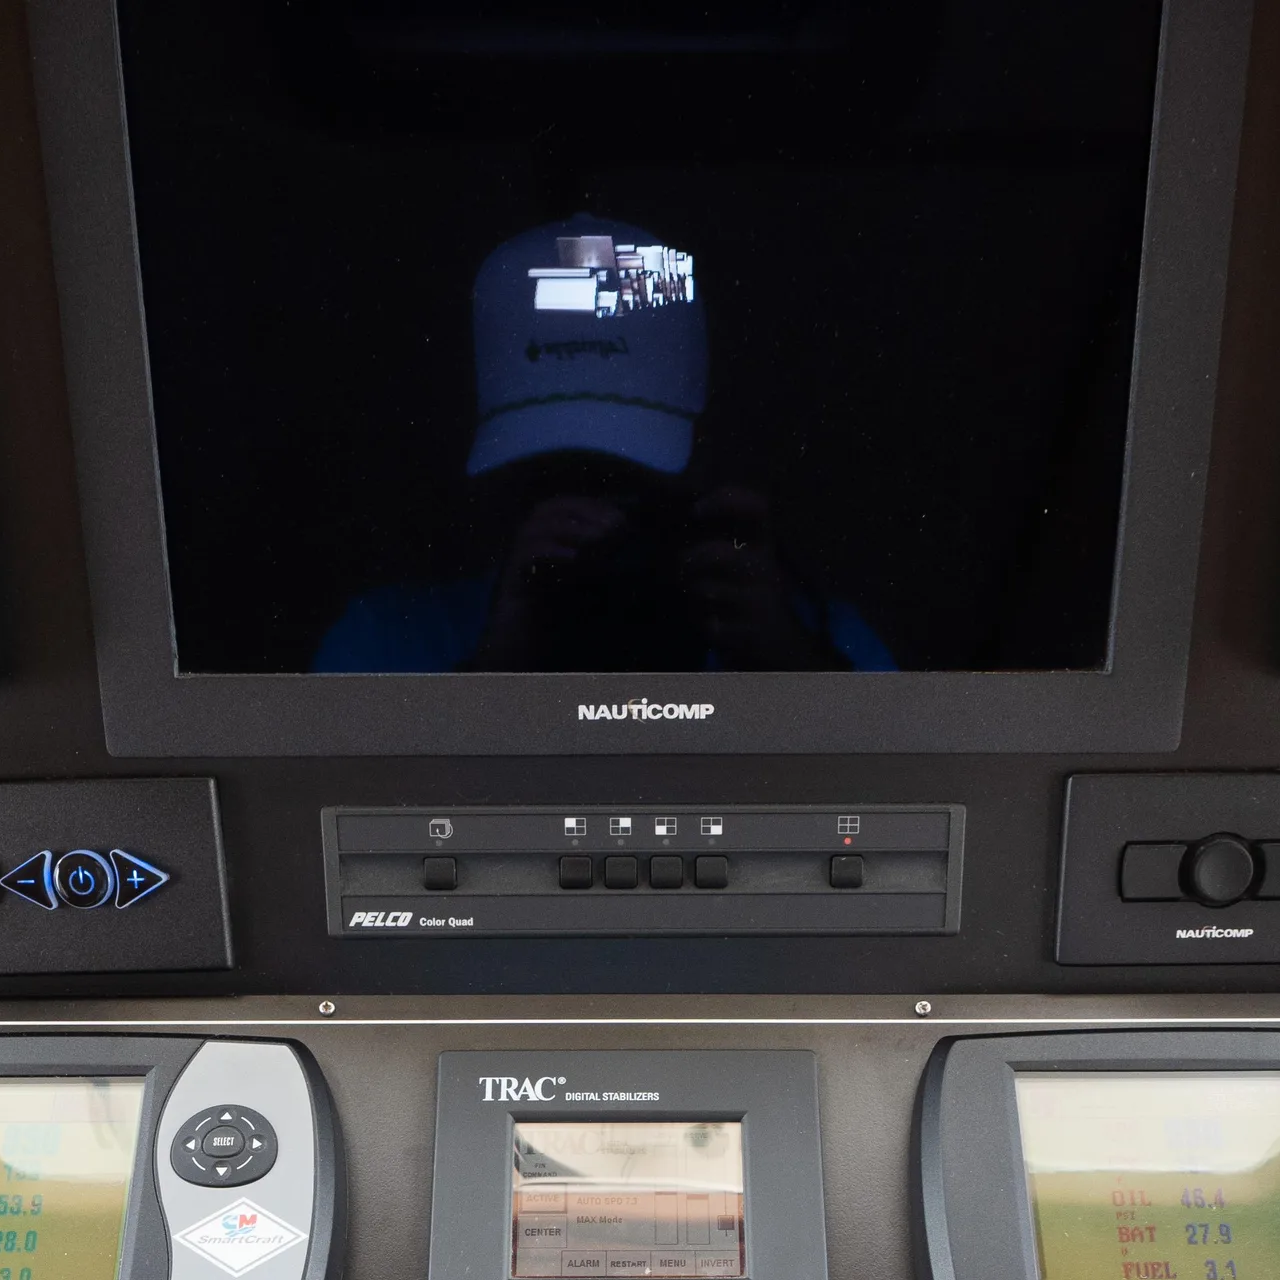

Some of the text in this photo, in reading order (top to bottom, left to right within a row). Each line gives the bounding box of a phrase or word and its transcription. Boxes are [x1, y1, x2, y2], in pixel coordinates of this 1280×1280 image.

[349, 912, 473, 927] PELCO Color Quad
[565, 1092, 601, 1101] DIGITAL
[602, 1092, 660, 1101] STABILIZERS
[213, 1137, 234, 1147] SELECT
[526, 1194, 560, 1203] ACTIVE
[577, 1197, 601, 1205] AUTO
[577, 1216, 623, 1224] MAX Mode
[524, 1228, 562, 1237] CENTER
[1117, 1223, 1232, 1245] BAT 27.9
[197, 1235, 284, 1244] SmartCraft
[567, 1259, 600, 1268] ALARM
[610, 1260, 647, 1268] RESTART
[659, 1259, 687, 1268] MENU
[700, 1259, 735, 1268] INVERT
[1122, 1259, 1237, 1280] FUEL 3.1
